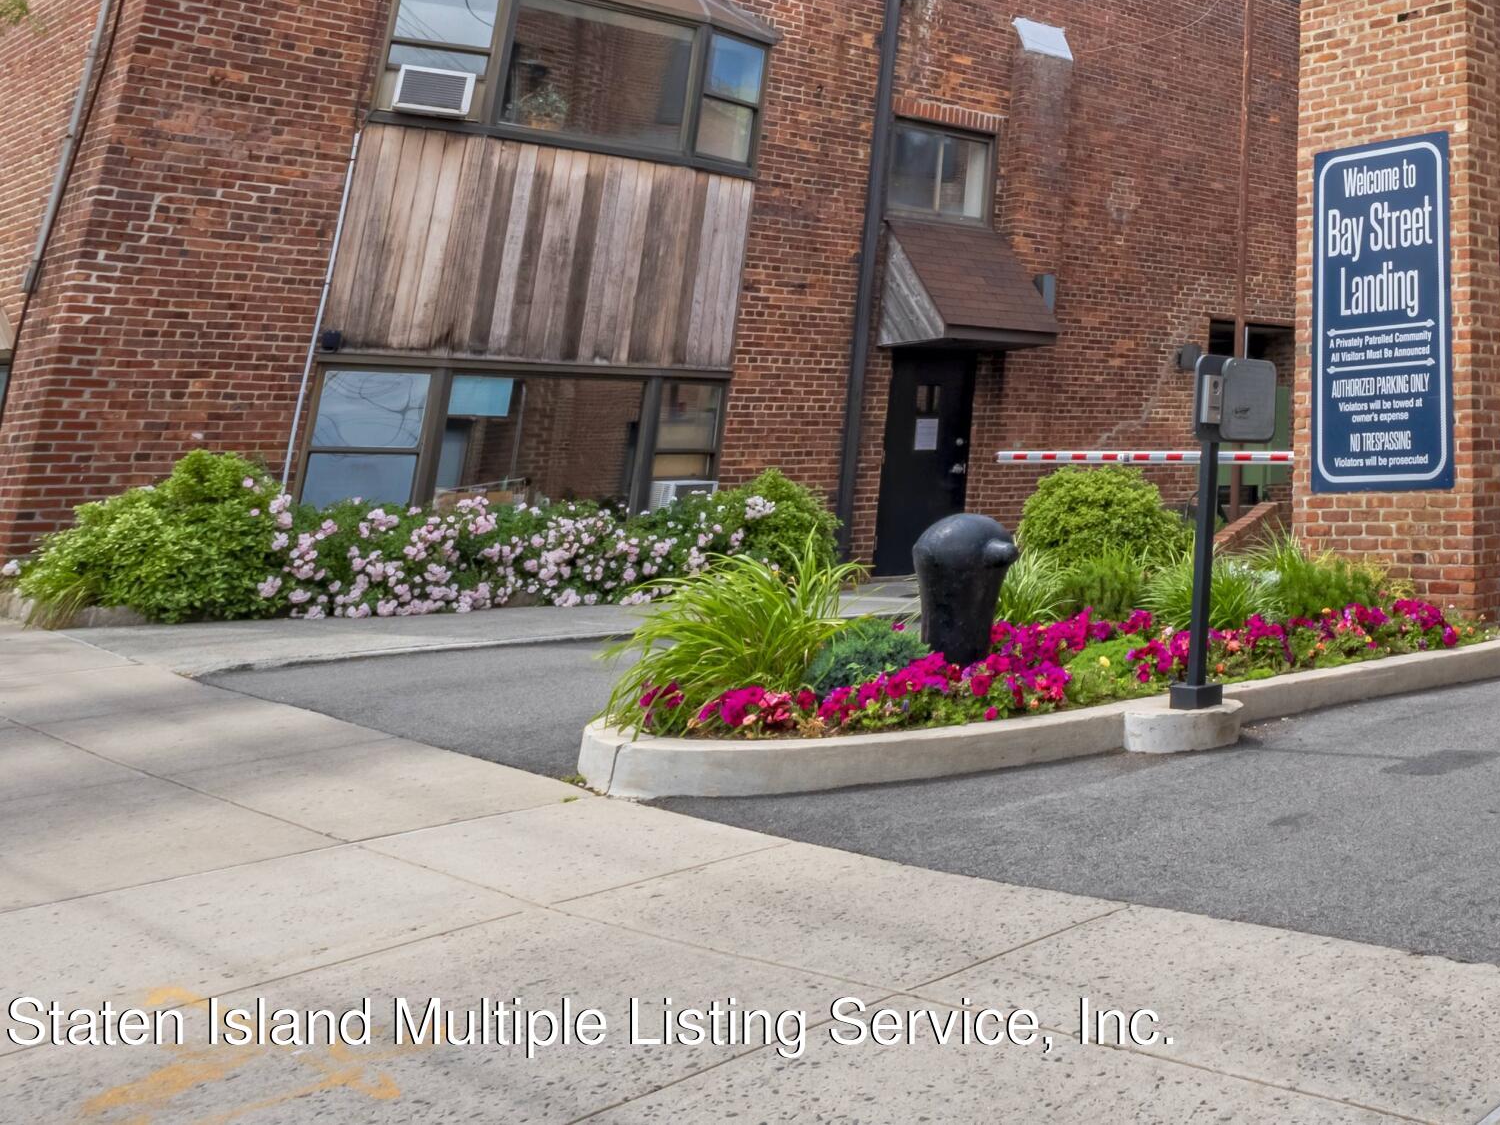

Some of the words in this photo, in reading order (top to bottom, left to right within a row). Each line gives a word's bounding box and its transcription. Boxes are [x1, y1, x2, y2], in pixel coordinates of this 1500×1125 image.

[1343, 165, 1400, 198] Welcome
[1403, 159, 1416, 189] to
[1328, 209, 1364, 263] Bay
[1370, 195, 1433, 252] Street
[1340, 261, 1418, 317] Landing
[1329, 339, 1335, 349] A
[1335, 336, 1363, 348] Privately
[1364, 333, 1393, 346] Patrolled
[1395, 330, 1432, 343] Community
[1331, 352, 1339, 363] All
[1341, 350, 1365, 362] Visitors
[1366, 349, 1382, 359] Must
[1384, 349, 1392, 358] Be
[1394, 345, 1430, 357] Announced
[1331, 377, 1375, 399] AUTHORIZED
[1376, 374, 1408, 396] PARKING
[1410, 373, 1430, 393] ONLY
[1338, 400, 1368, 412] Violators
[1369, 400, 1381, 410] will
[1382, 399, 1391, 409] be
[1392, 398, 1414, 409] towed
[1415, 397, 1423, 408] at
[1351, 412, 1378, 423] owner's
[1380, 412, 1409, 424] expense
[1350, 432, 1361, 453] NO
[1362, 430, 1412, 452] TRESPASSING
[1334, 457, 1364, 468] Violators
[1365, 456, 1377, 467] will
[1378, 455, 1387, 466] be
[1388, 454, 1429, 467] prosecuted
